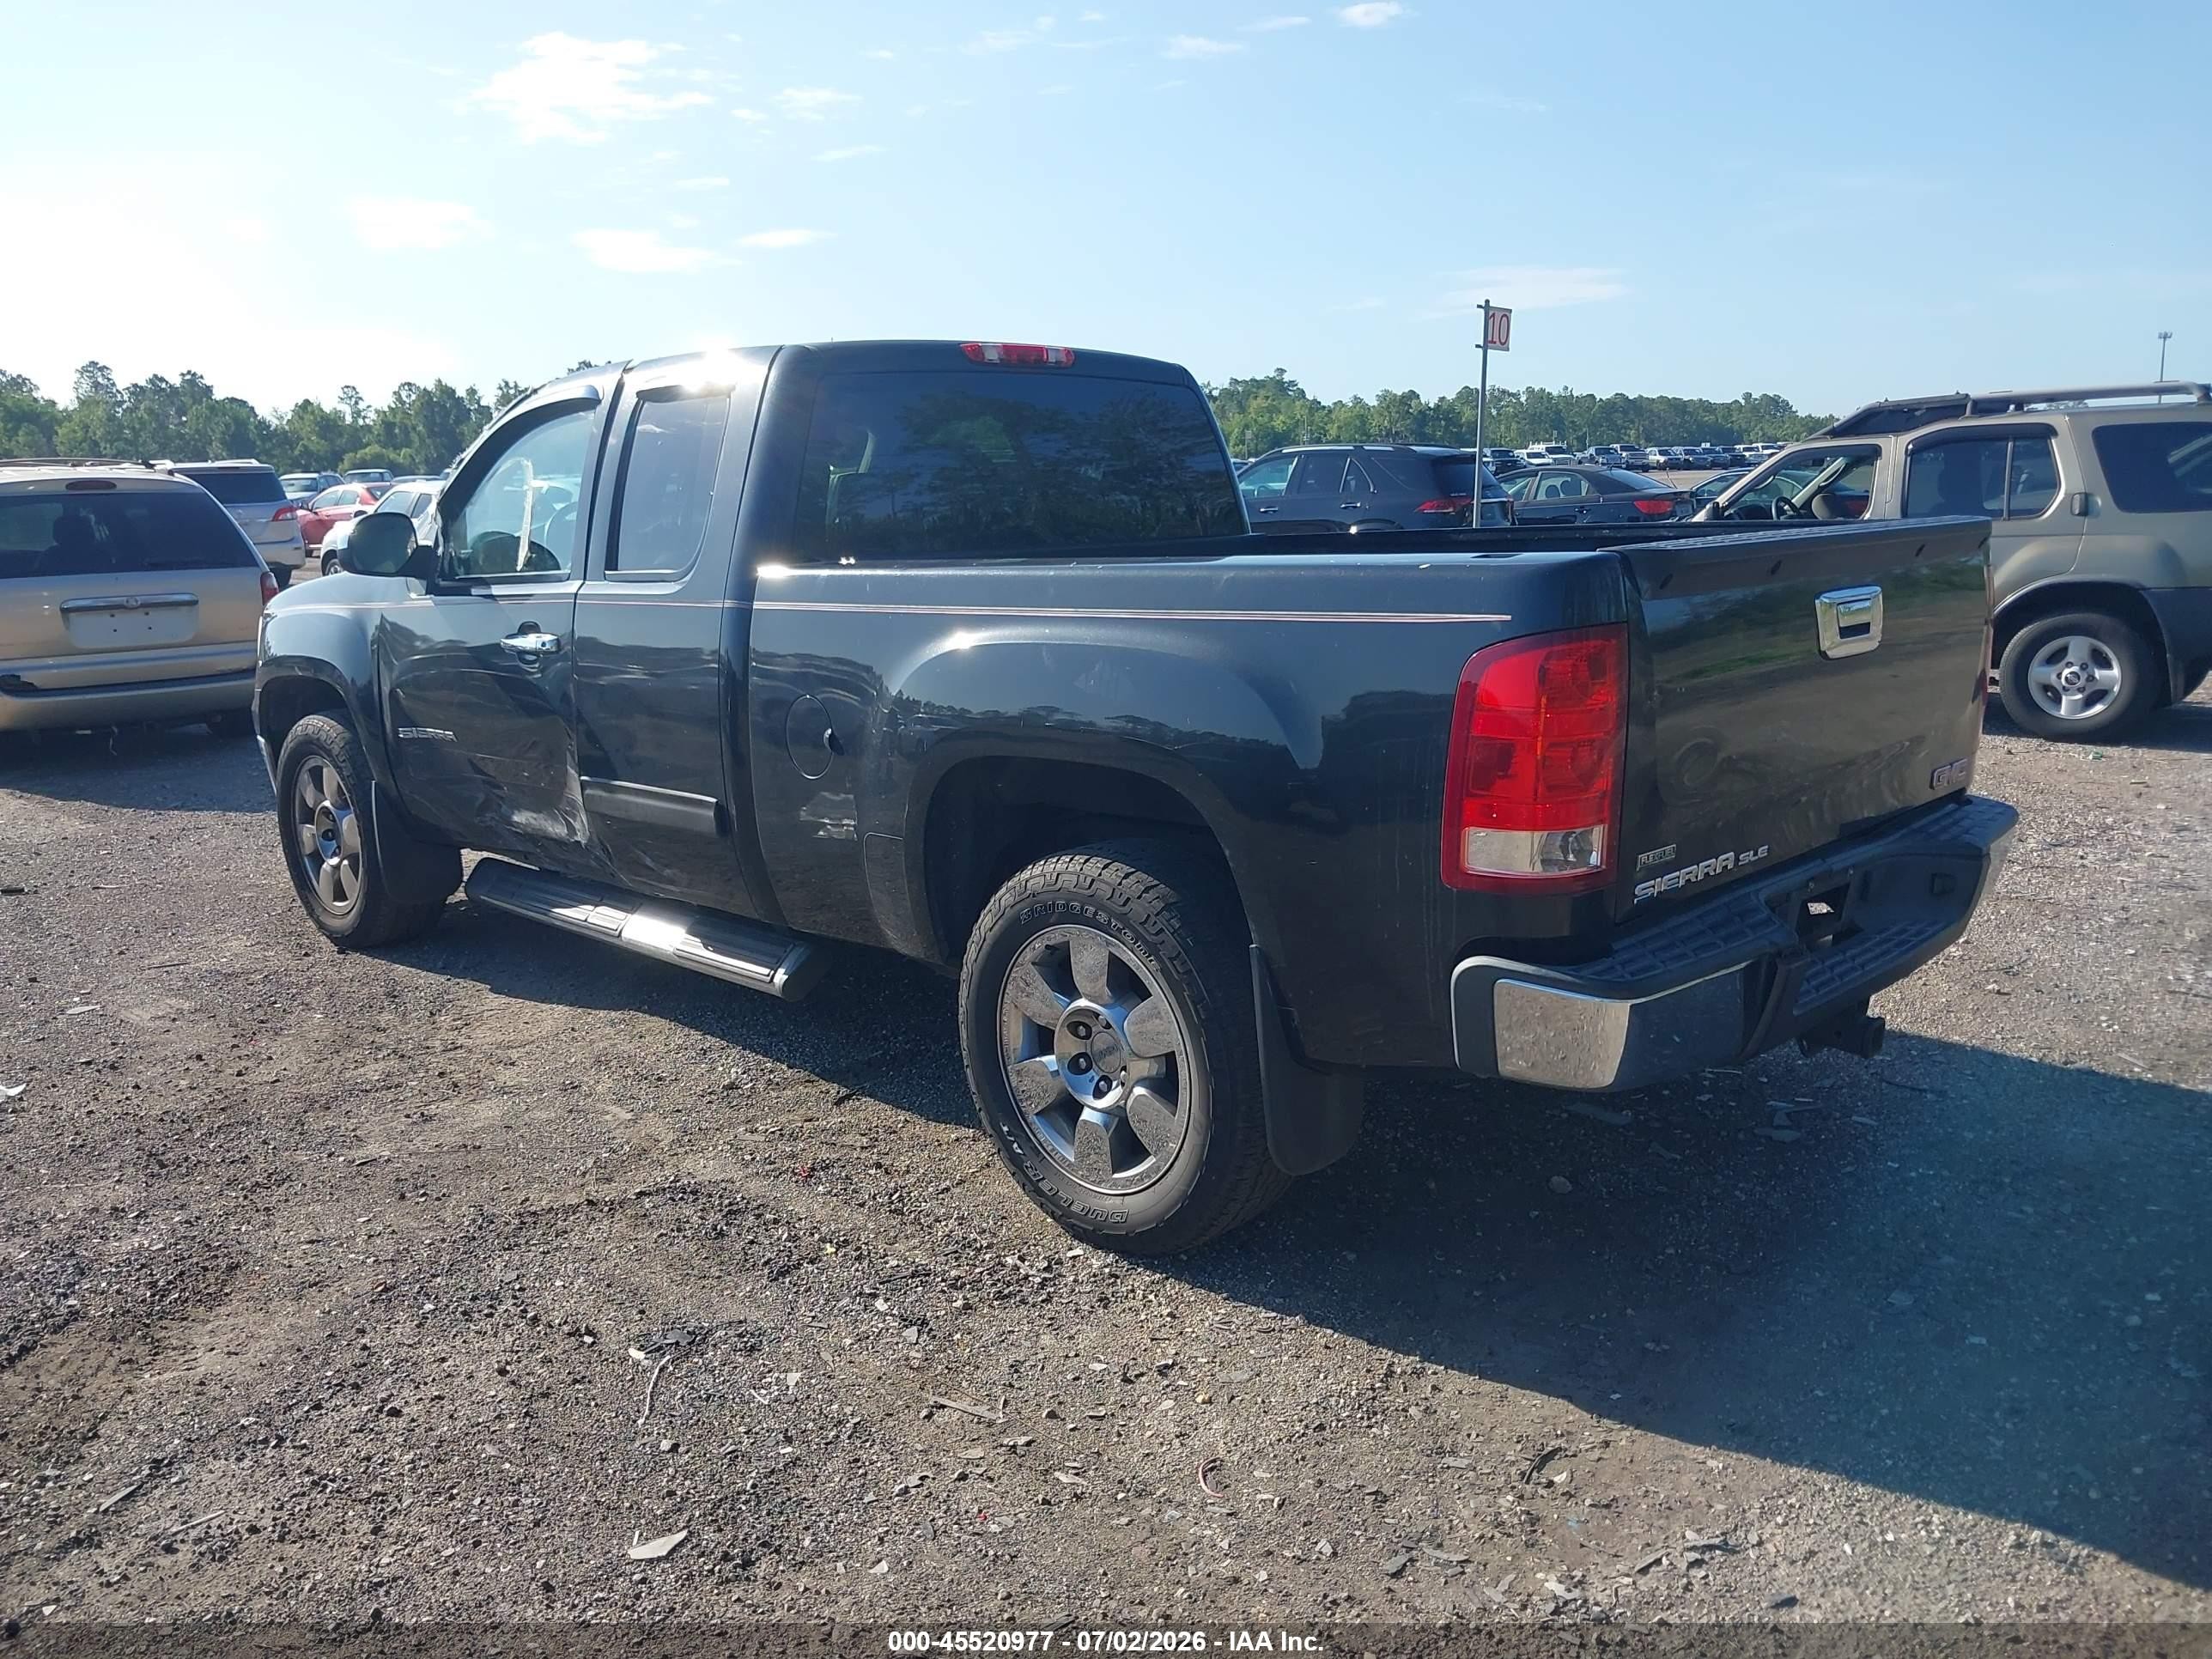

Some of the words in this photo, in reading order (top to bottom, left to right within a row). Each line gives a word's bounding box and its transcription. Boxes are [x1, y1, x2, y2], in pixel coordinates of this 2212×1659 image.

[1488, 312, 1510, 346] 10
[398, 727, 458, 743] SIERRA
[1633, 851, 1735, 904] SIERRA
[1738, 845, 1769, 866] SLE
[1019, 901, 1161, 971] BRIDGESTONE
[1024, 1160, 1128, 1223] DUELER
